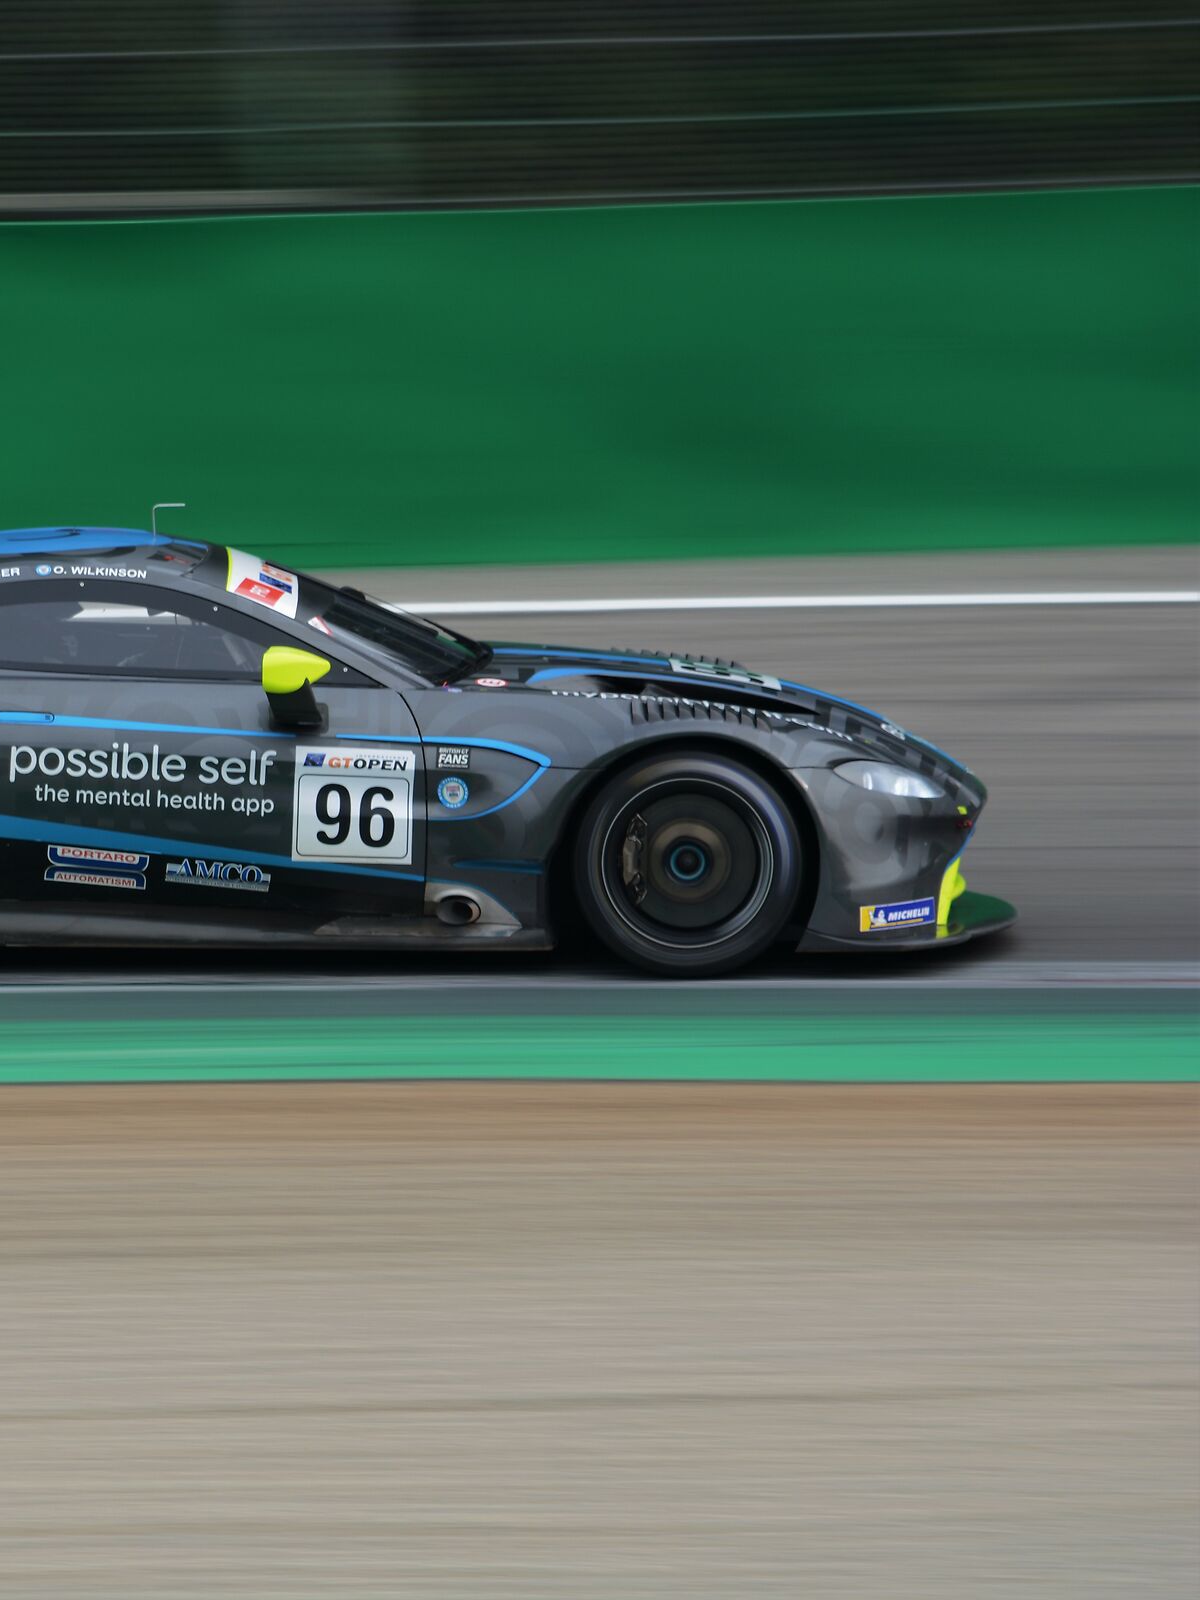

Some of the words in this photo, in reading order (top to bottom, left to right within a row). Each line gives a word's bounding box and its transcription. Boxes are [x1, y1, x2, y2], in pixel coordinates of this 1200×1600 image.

[53, 566, 67, 575] O.
[71, 566, 148, 579] WILKINSON
[9, 742, 187, 783] possible
[199, 749, 277, 786] self
[438, 754, 469, 765] FANS
[35, 784, 70, 802] the
[76, 789, 150, 807] mental
[157, 790, 225, 811] health
[231, 797, 275, 817] app
[315, 783, 395, 848] 96
[60, 848, 136, 863] PORTARO
[176, 858, 264, 883] AMCO
[56, 872, 135, 887] AUTOMATISMI
[887, 907, 930, 921] MICHELIN
